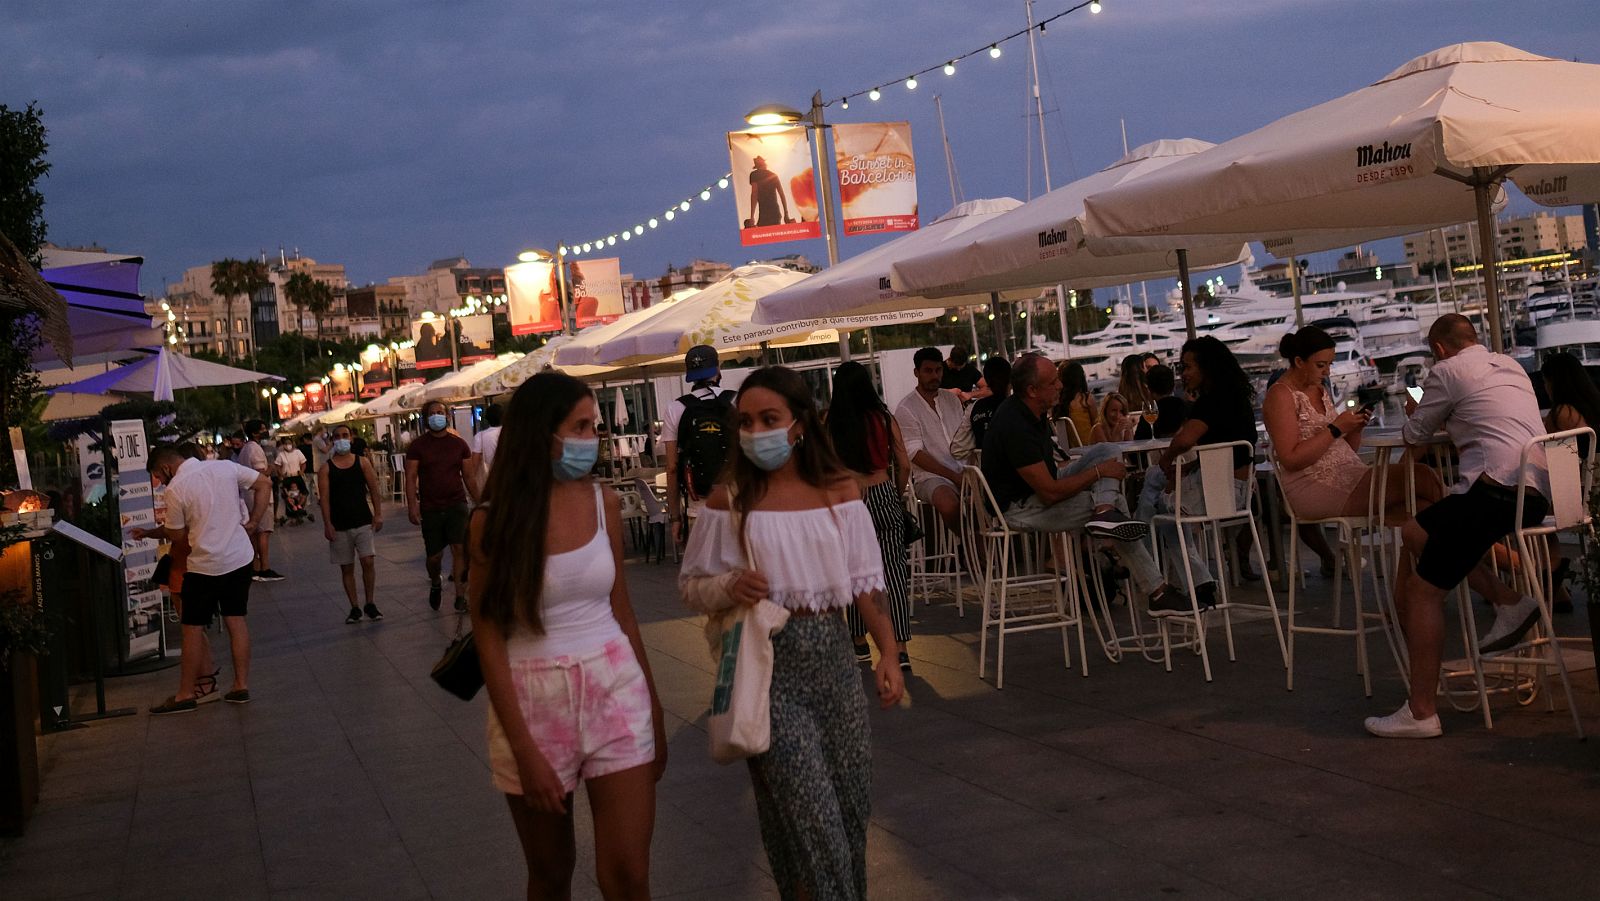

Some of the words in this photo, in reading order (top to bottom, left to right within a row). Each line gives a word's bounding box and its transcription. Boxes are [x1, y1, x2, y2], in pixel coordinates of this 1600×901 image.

[850, 155, 892, 171] Sunset
[894, 156, 906, 169] in
[1356, 141, 1412, 167] Mahou
[841, 168, 914, 186] Barcelona
[1357, 169, 1385, 183] DESDE
[1389, 164, 1414, 177] 1890
[1038, 228, 1067, 248] Mahou
[722, 333, 742, 344] Este
[743, 327, 775, 341] parasol
[776, 319, 819, 333] contribuye
[829, 317, 845, 325] que
[846, 314, 879, 324] respires
[880, 311, 898, 321] más
[900, 310, 924, 320] limpio
[126, 434, 141, 458] ONE
